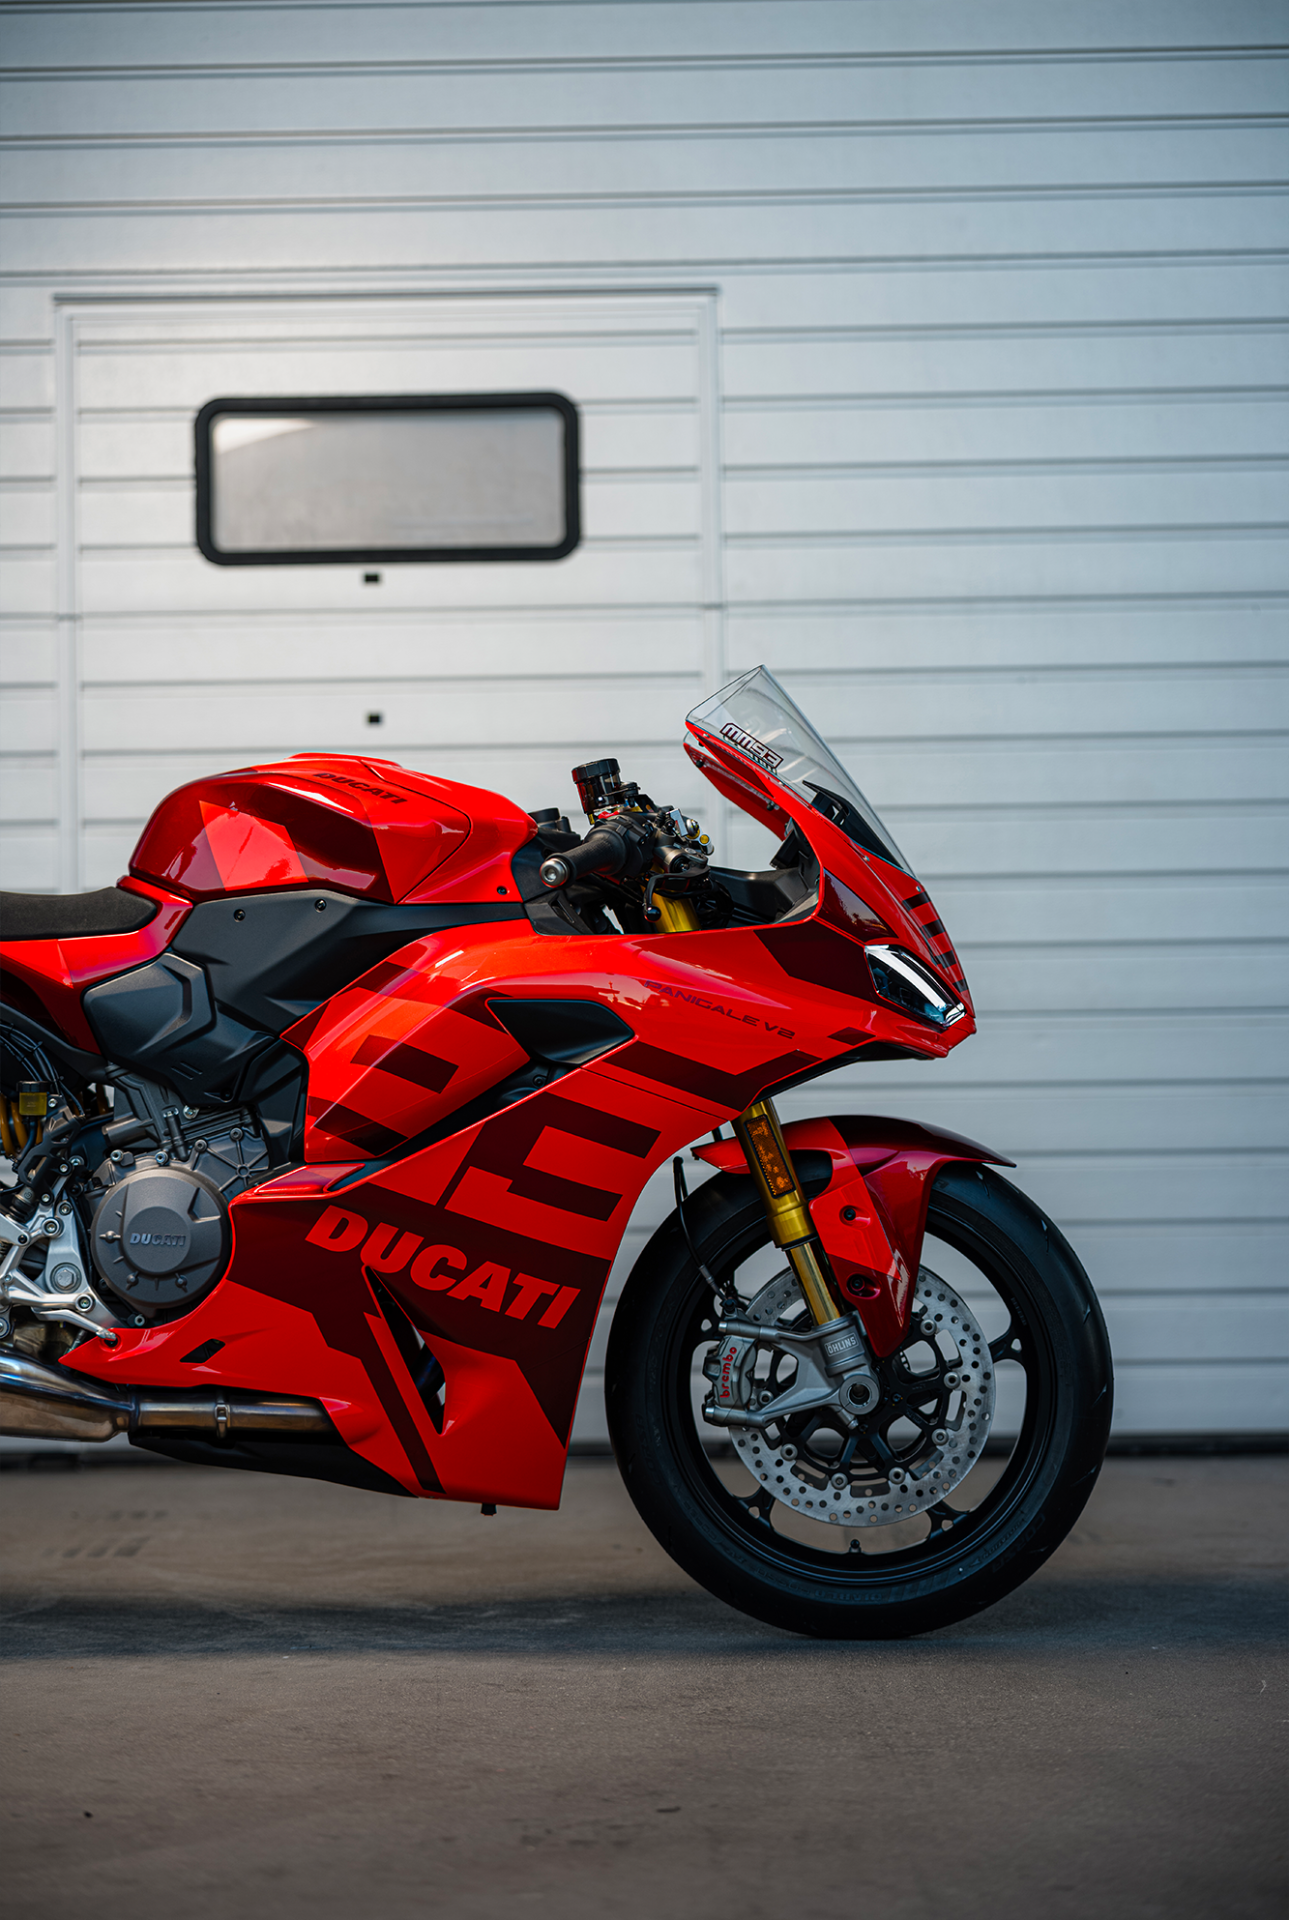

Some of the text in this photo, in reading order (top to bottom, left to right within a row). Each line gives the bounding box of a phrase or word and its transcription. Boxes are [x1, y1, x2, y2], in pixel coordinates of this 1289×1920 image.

[312, 772, 408, 804] DUCATI
[643, 979, 796, 1040] PANIGALE V2
[130, 1233, 186, 1246] DUCATI
[294, 1204, 581, 1329] DUCATI
[827, 1336, 857, 1355] ÖHLINS
[719, 1346, 737, 1399] brembo
[988, 1511, 1048, 1575] CORSA
